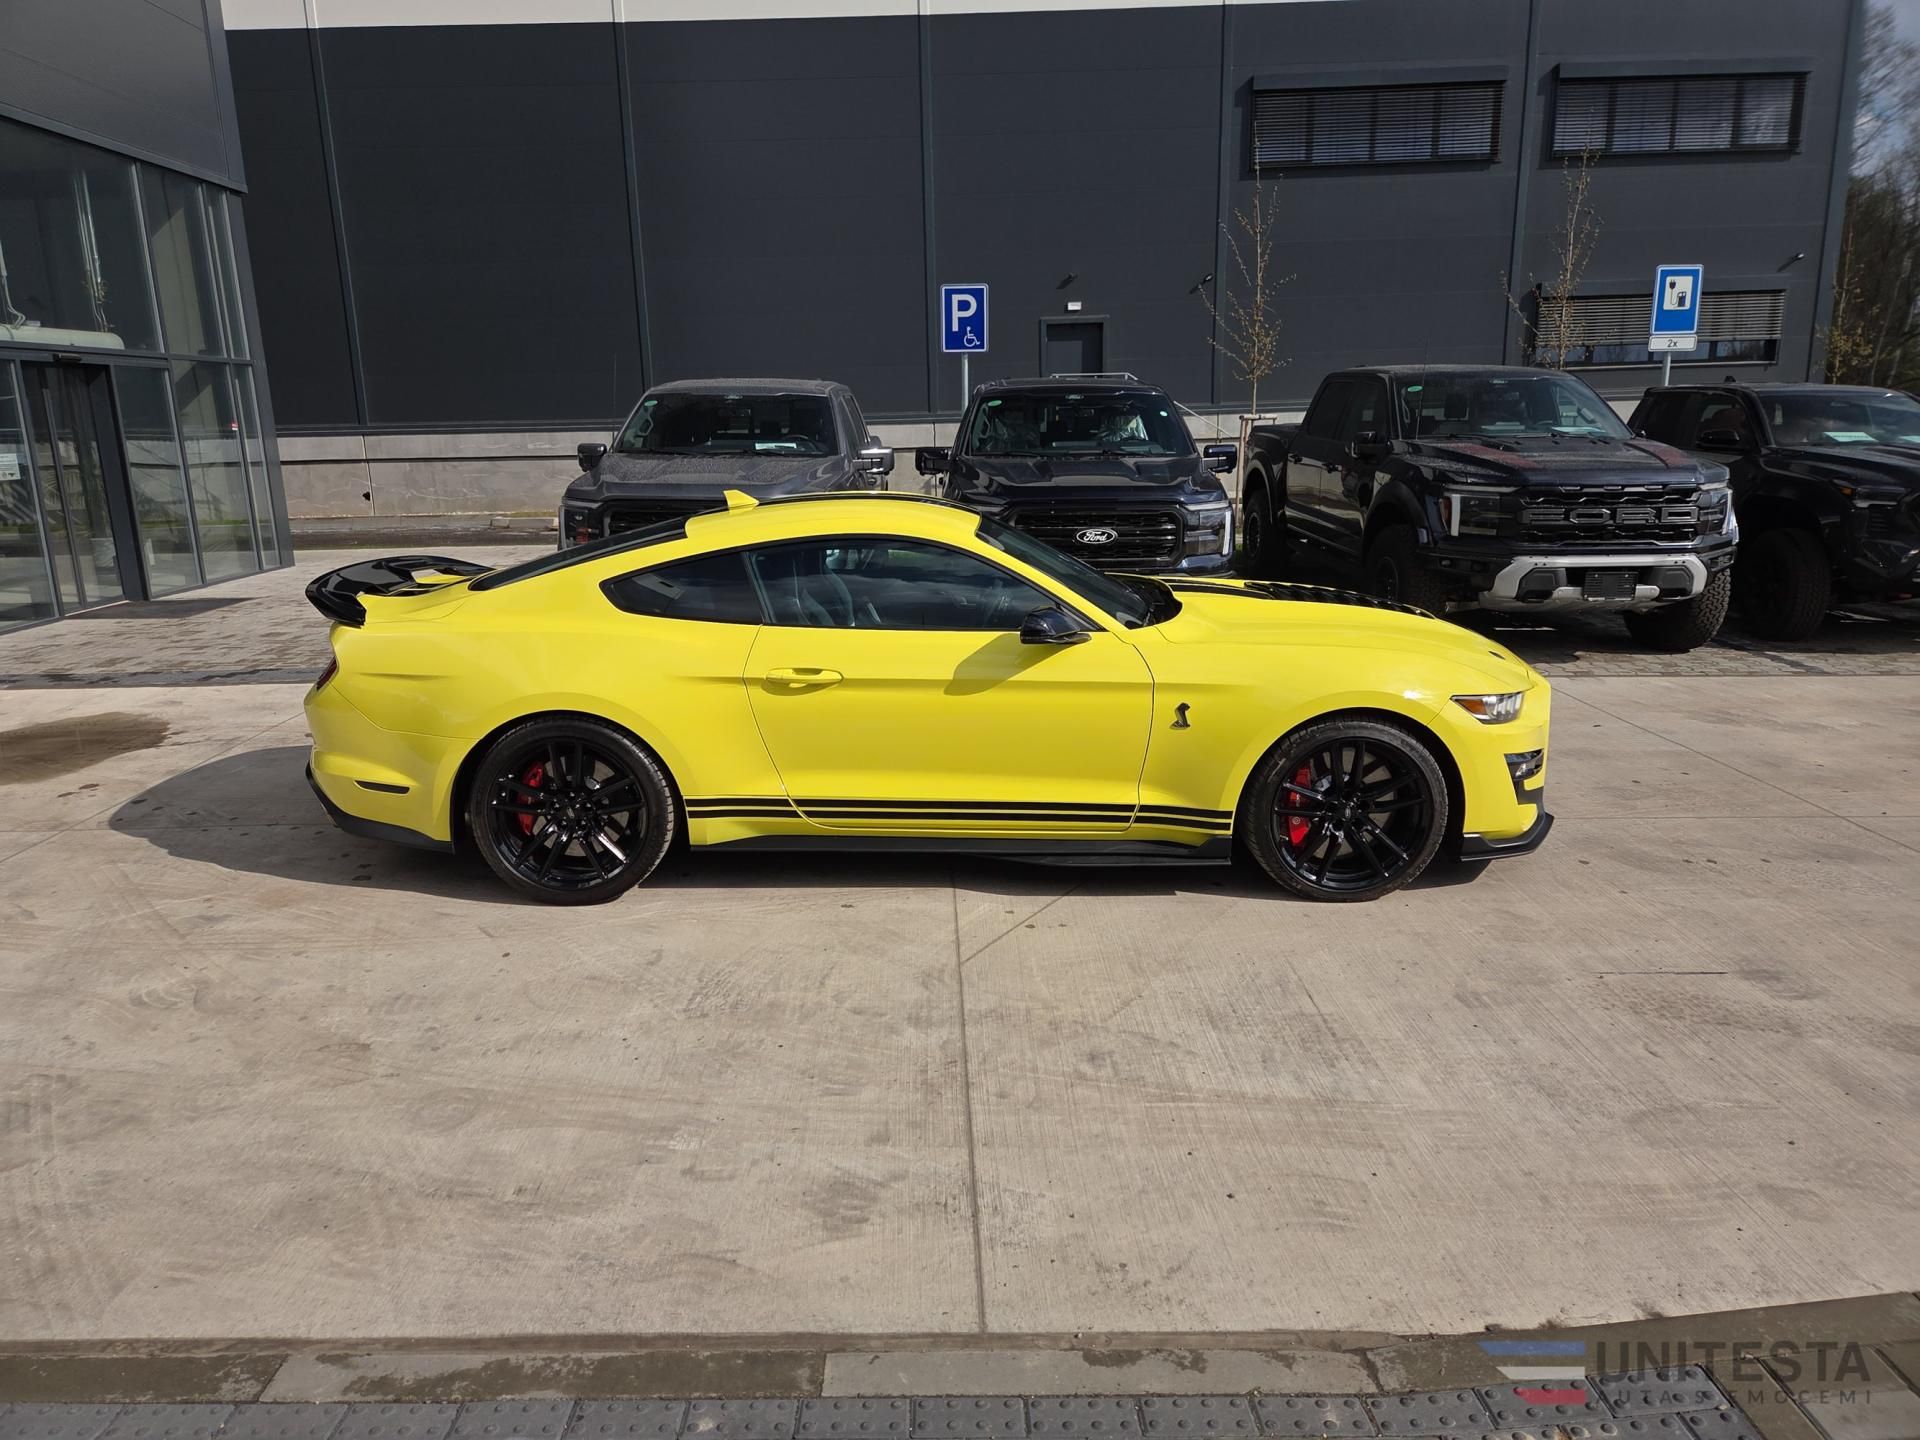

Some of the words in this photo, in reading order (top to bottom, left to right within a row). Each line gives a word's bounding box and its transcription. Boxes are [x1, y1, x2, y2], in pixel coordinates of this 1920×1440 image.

[952, 294, 977, 332] P
[1667, 339, 1678, 348] 2x
[1519, 507, 1699, 524] FORD
[1083, 531, 1108, 541] Ford
